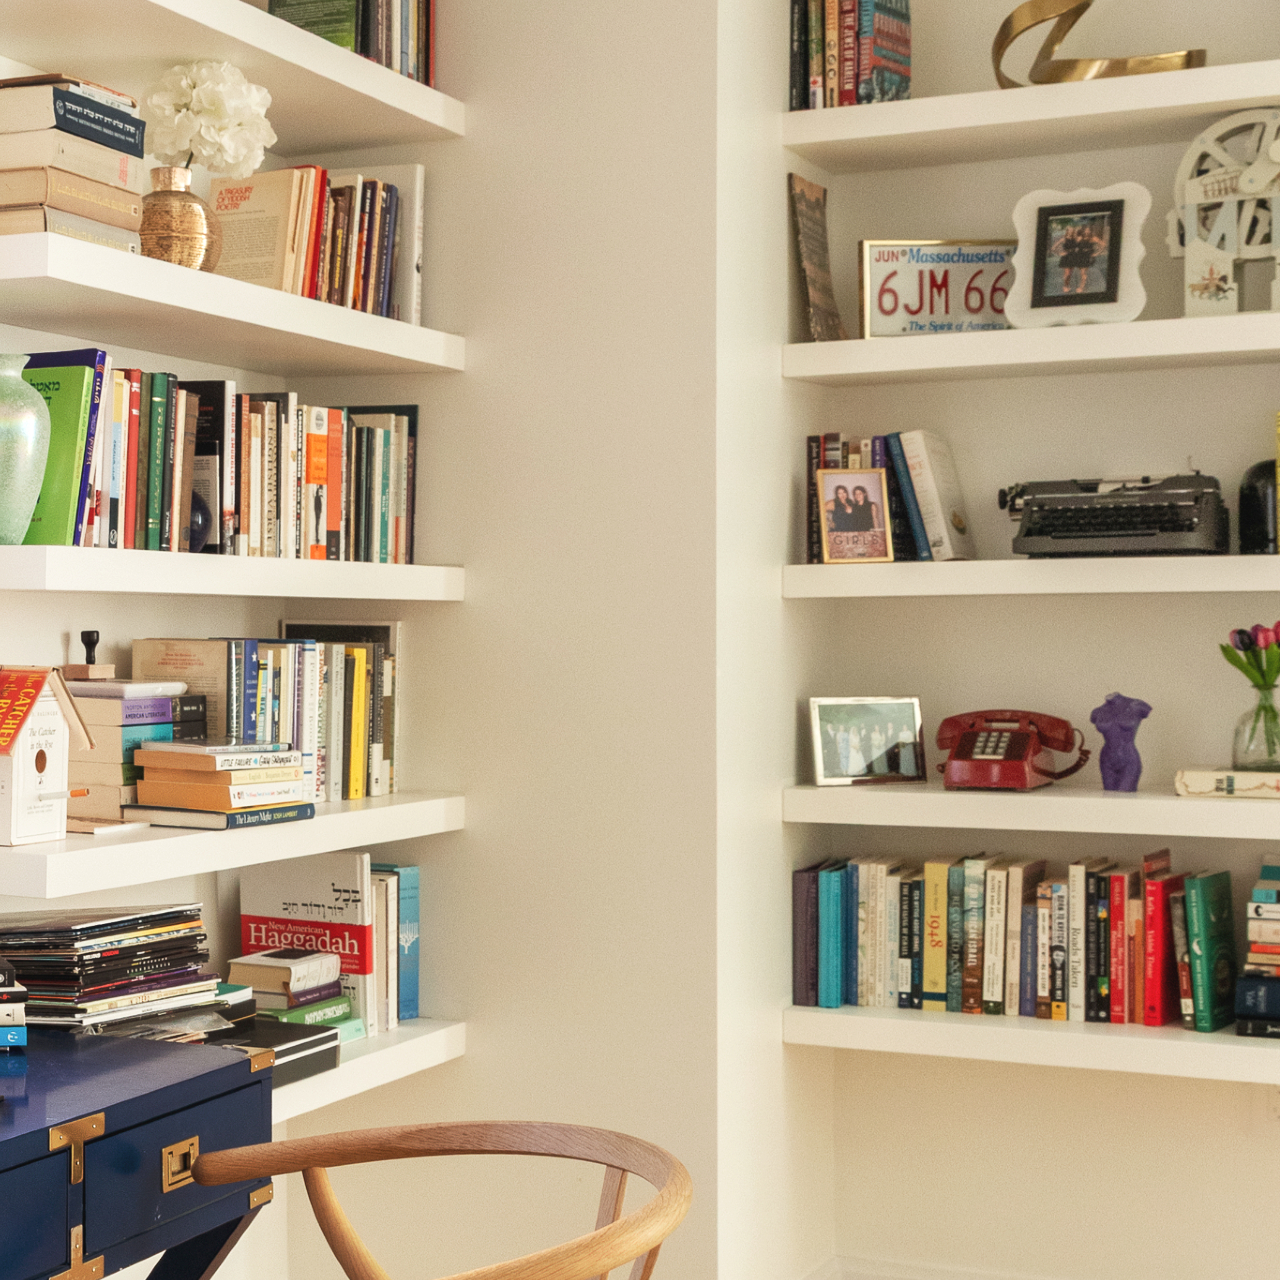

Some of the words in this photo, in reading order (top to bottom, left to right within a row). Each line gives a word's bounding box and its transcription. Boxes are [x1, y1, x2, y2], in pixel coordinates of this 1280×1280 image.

[844, 14, 854, 25] THE
[844, 29, 854, 48] JEWS
[844, 50, 854, 58] OF
[844, 61, 854, 90] HARLEM
[875, 250, 899, 262] JUN
[907, 247, 1005, 264] Massachusetts
[878, 269, 950, 315] 6JM
[909, 321, 927, 331] The
[928, 321, 953, 332] Spirit
[955, 320, 964, 332] of
[967, 320, 1005, 330] America
[833, 535, 880, 546] GIRLS
[24, 674, 43, 688] the
[2, 683, 18, 698] the
[28, 728, 37, 737] The
[38, 727, 56, 736] Catcher
[220, 758, 234, 768] LITTLE
[234, 757, 253, 767] FAILURE
[235, 814, 243, 825] The
[243, 813, 259, 824] Literary
[259, 811, 273, 822] Mafia
[282, 810, 298, 819] LAMBERT
[1057, 895, 1065, 911] BORN
[951, 896, 960, 952] RECOVERED
[967, 900, 979, 940] AMERICAN
[1057, 913, 1065, 921] TO
[269, 922, 286, 931] New
[286, 923, 325, 935] American
[926, 914, 944, 948] 1948
[248, 923, 360, 956] Haggadah
[1071, 927, 1082, 957] Roads
[967, 940, 979, 967] ISRAEL
[951, 953, 959, 986] ROOTS
[1071, 958, 1081, 989] Taken
